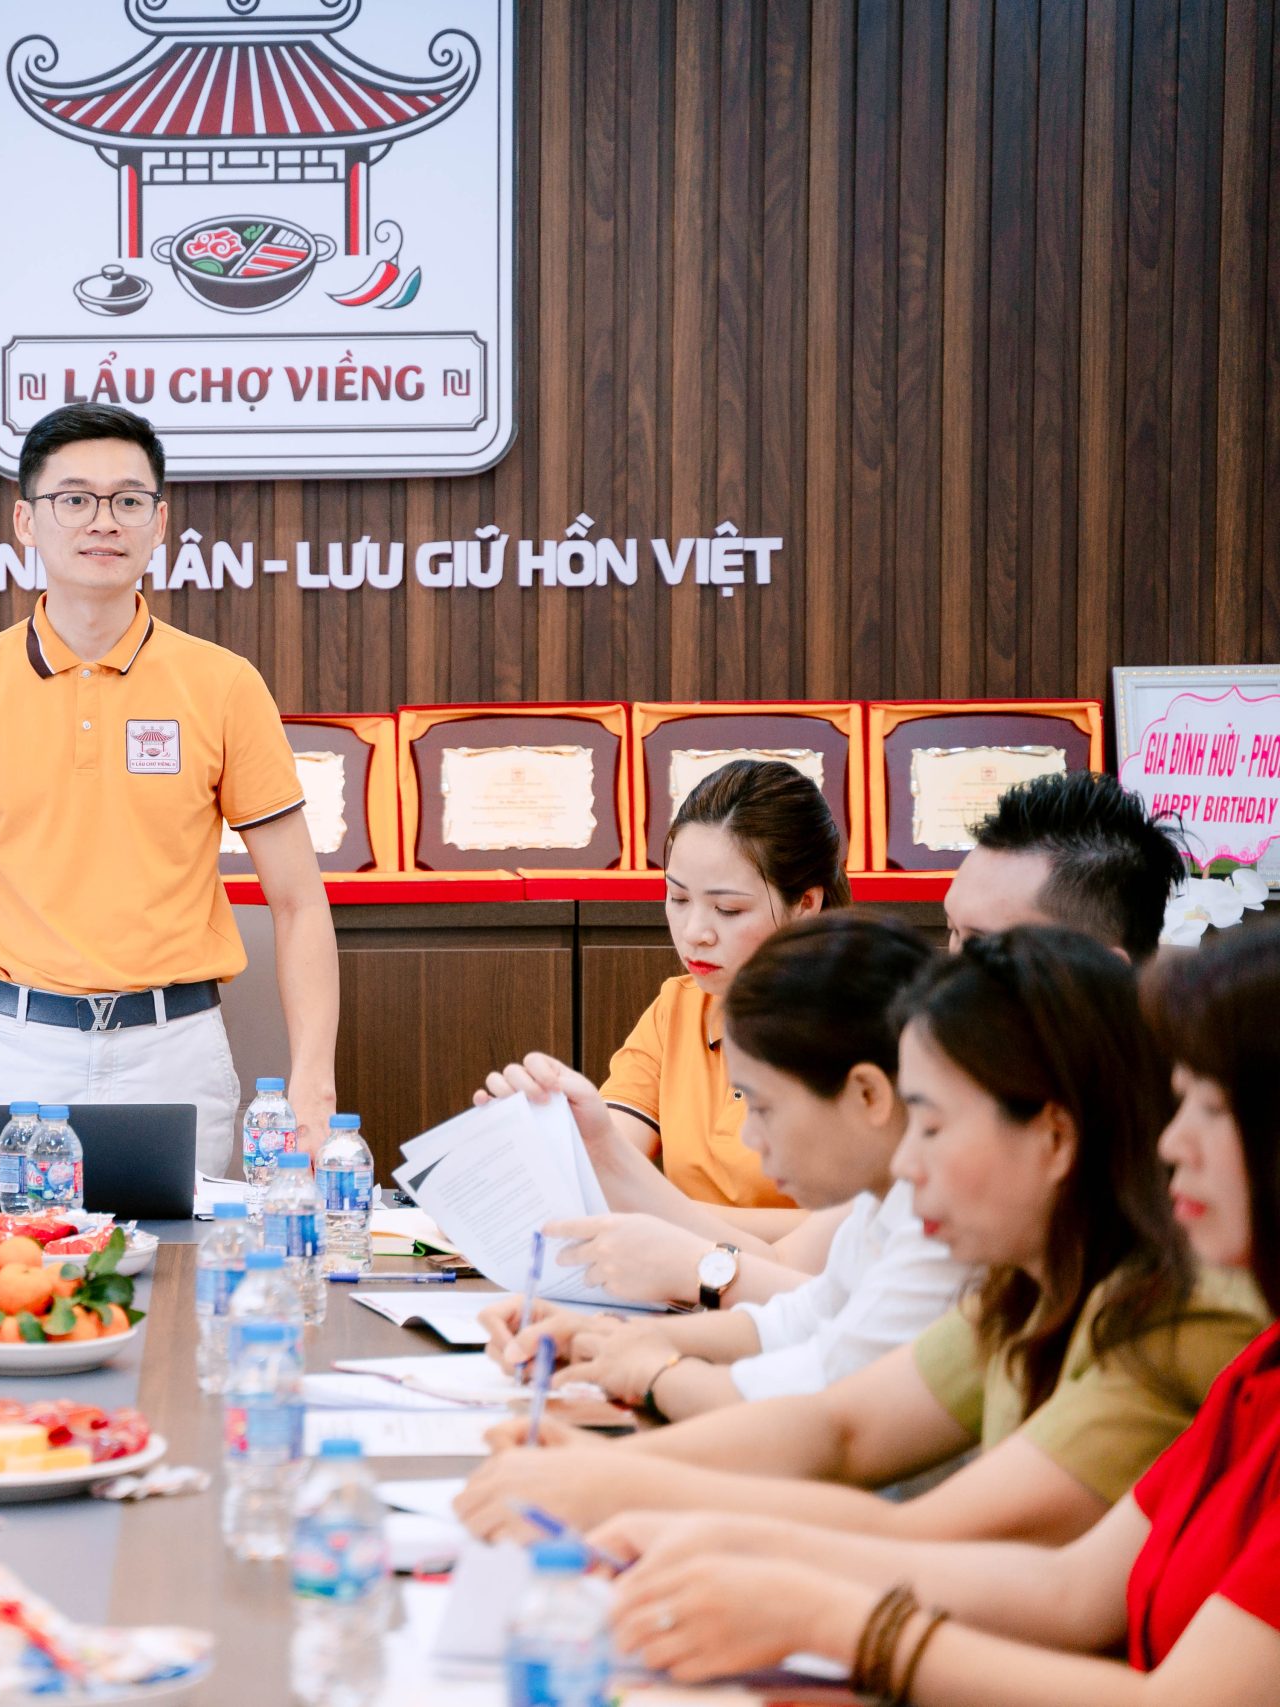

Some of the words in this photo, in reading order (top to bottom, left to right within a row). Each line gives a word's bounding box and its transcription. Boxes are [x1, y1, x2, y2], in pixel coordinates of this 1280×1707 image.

[64, 350, 155, 404] LẨU
[168, 365, 274, 412] CHỢ
[284, 349, 425, 402] VIỀNG
[135, 527, 254, 590] HÂN
[263, 559, 288, 572] -
[296, 535, 404, 589] LƯU
[415, 524, 509, 589] GIỮ
[518, 512, 638, 588] HỒN
[651, 520, 783, 597] VIỆT
[1144, 732, 1169, 775] GIA
[1169, 722, 1208, 776] ĐÌNH
[1247, 733, 1280, 779] PHO
[1151, 793, 1201, 821] HAPPY
[1203, 795, 1278, 824] BIRTHDAY
